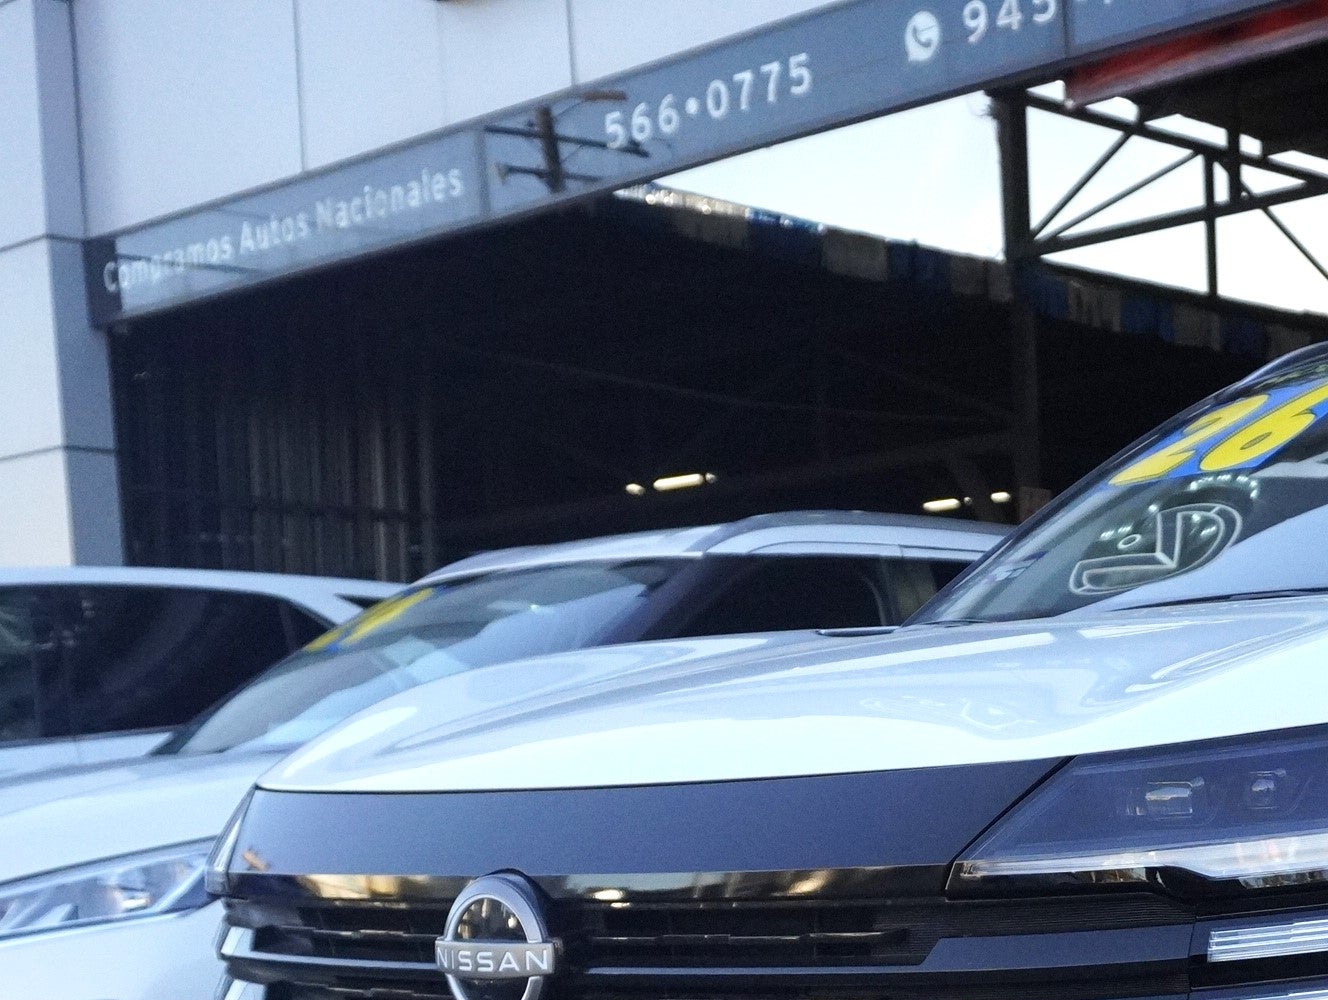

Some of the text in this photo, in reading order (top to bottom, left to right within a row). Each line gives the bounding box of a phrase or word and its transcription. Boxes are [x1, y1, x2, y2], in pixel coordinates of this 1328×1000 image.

[103, 167, 463, 293] Compramos Autos Nacionales
[437, 947, 547, 972] NISSAN
